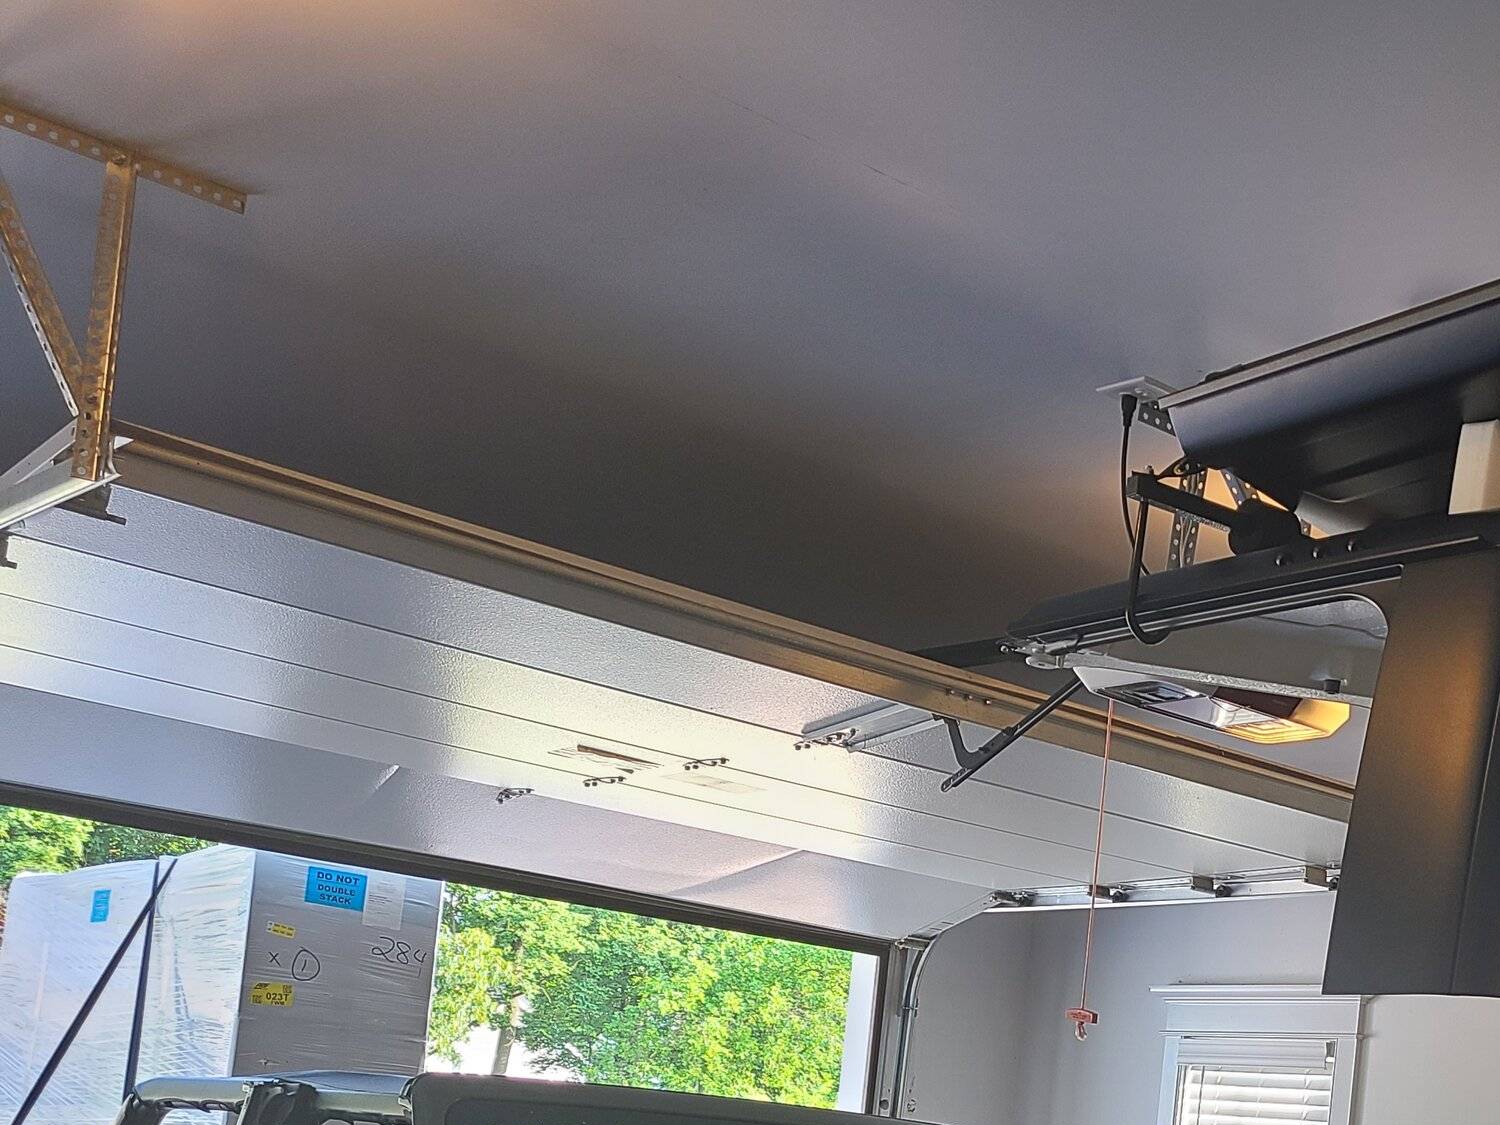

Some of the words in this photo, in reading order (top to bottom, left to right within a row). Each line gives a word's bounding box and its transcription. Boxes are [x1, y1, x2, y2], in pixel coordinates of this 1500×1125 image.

[317, 871, 333, 881] DO
[336, 875, 360, 885] NOT
[317, 883, 356, 897] DOUBLE
[319, 893, 352, 905] STACK
